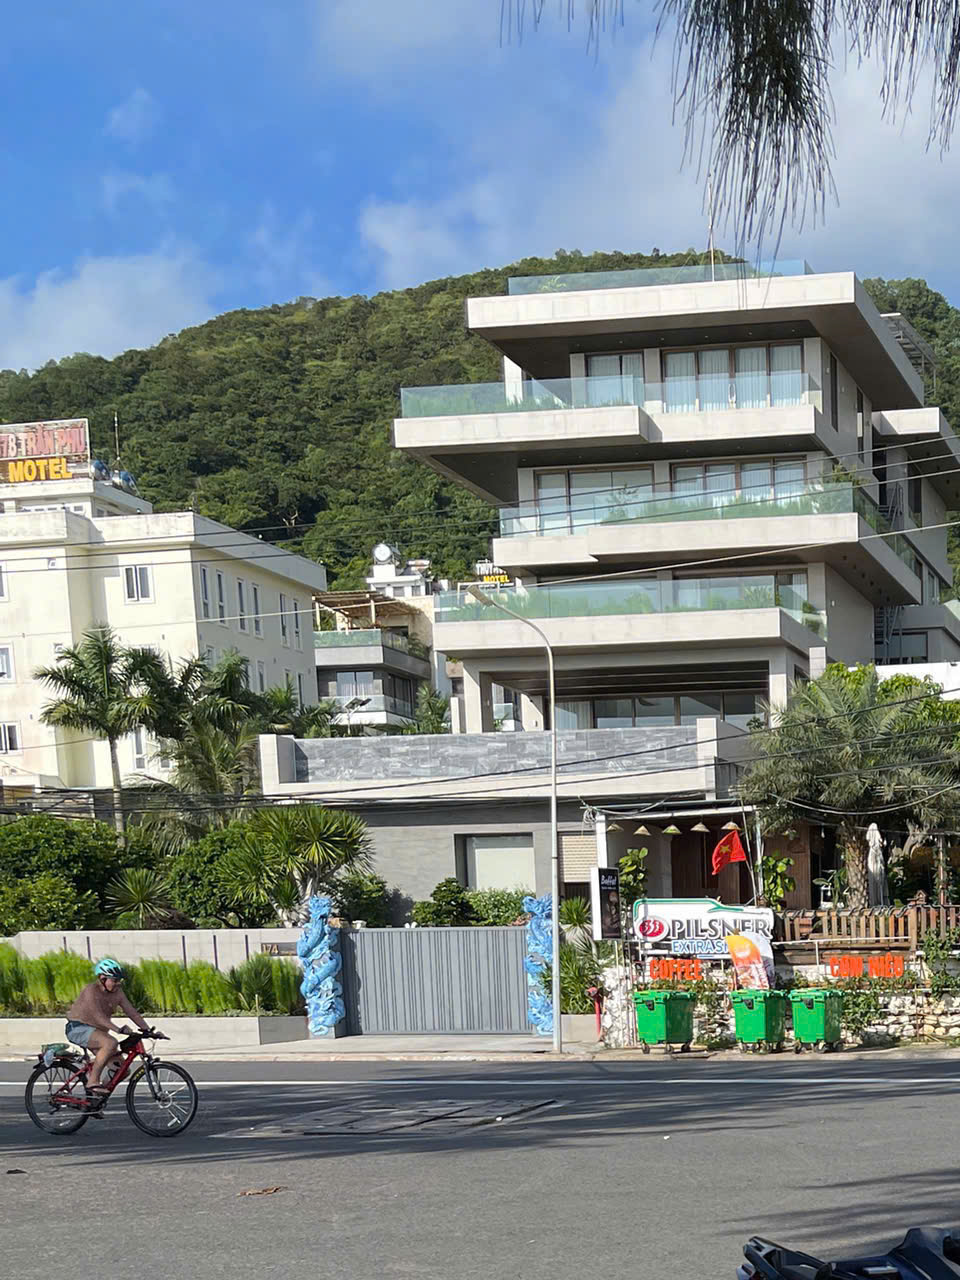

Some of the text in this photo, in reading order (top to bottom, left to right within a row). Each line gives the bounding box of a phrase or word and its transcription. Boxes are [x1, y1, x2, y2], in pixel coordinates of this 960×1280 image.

[8, 457, 73, 482] MOTEL
[483, 574, 510, 583] MOTEL
[671, 918, 774, 939] PILSNER
[649, 958, 704, 981] COFFEE
